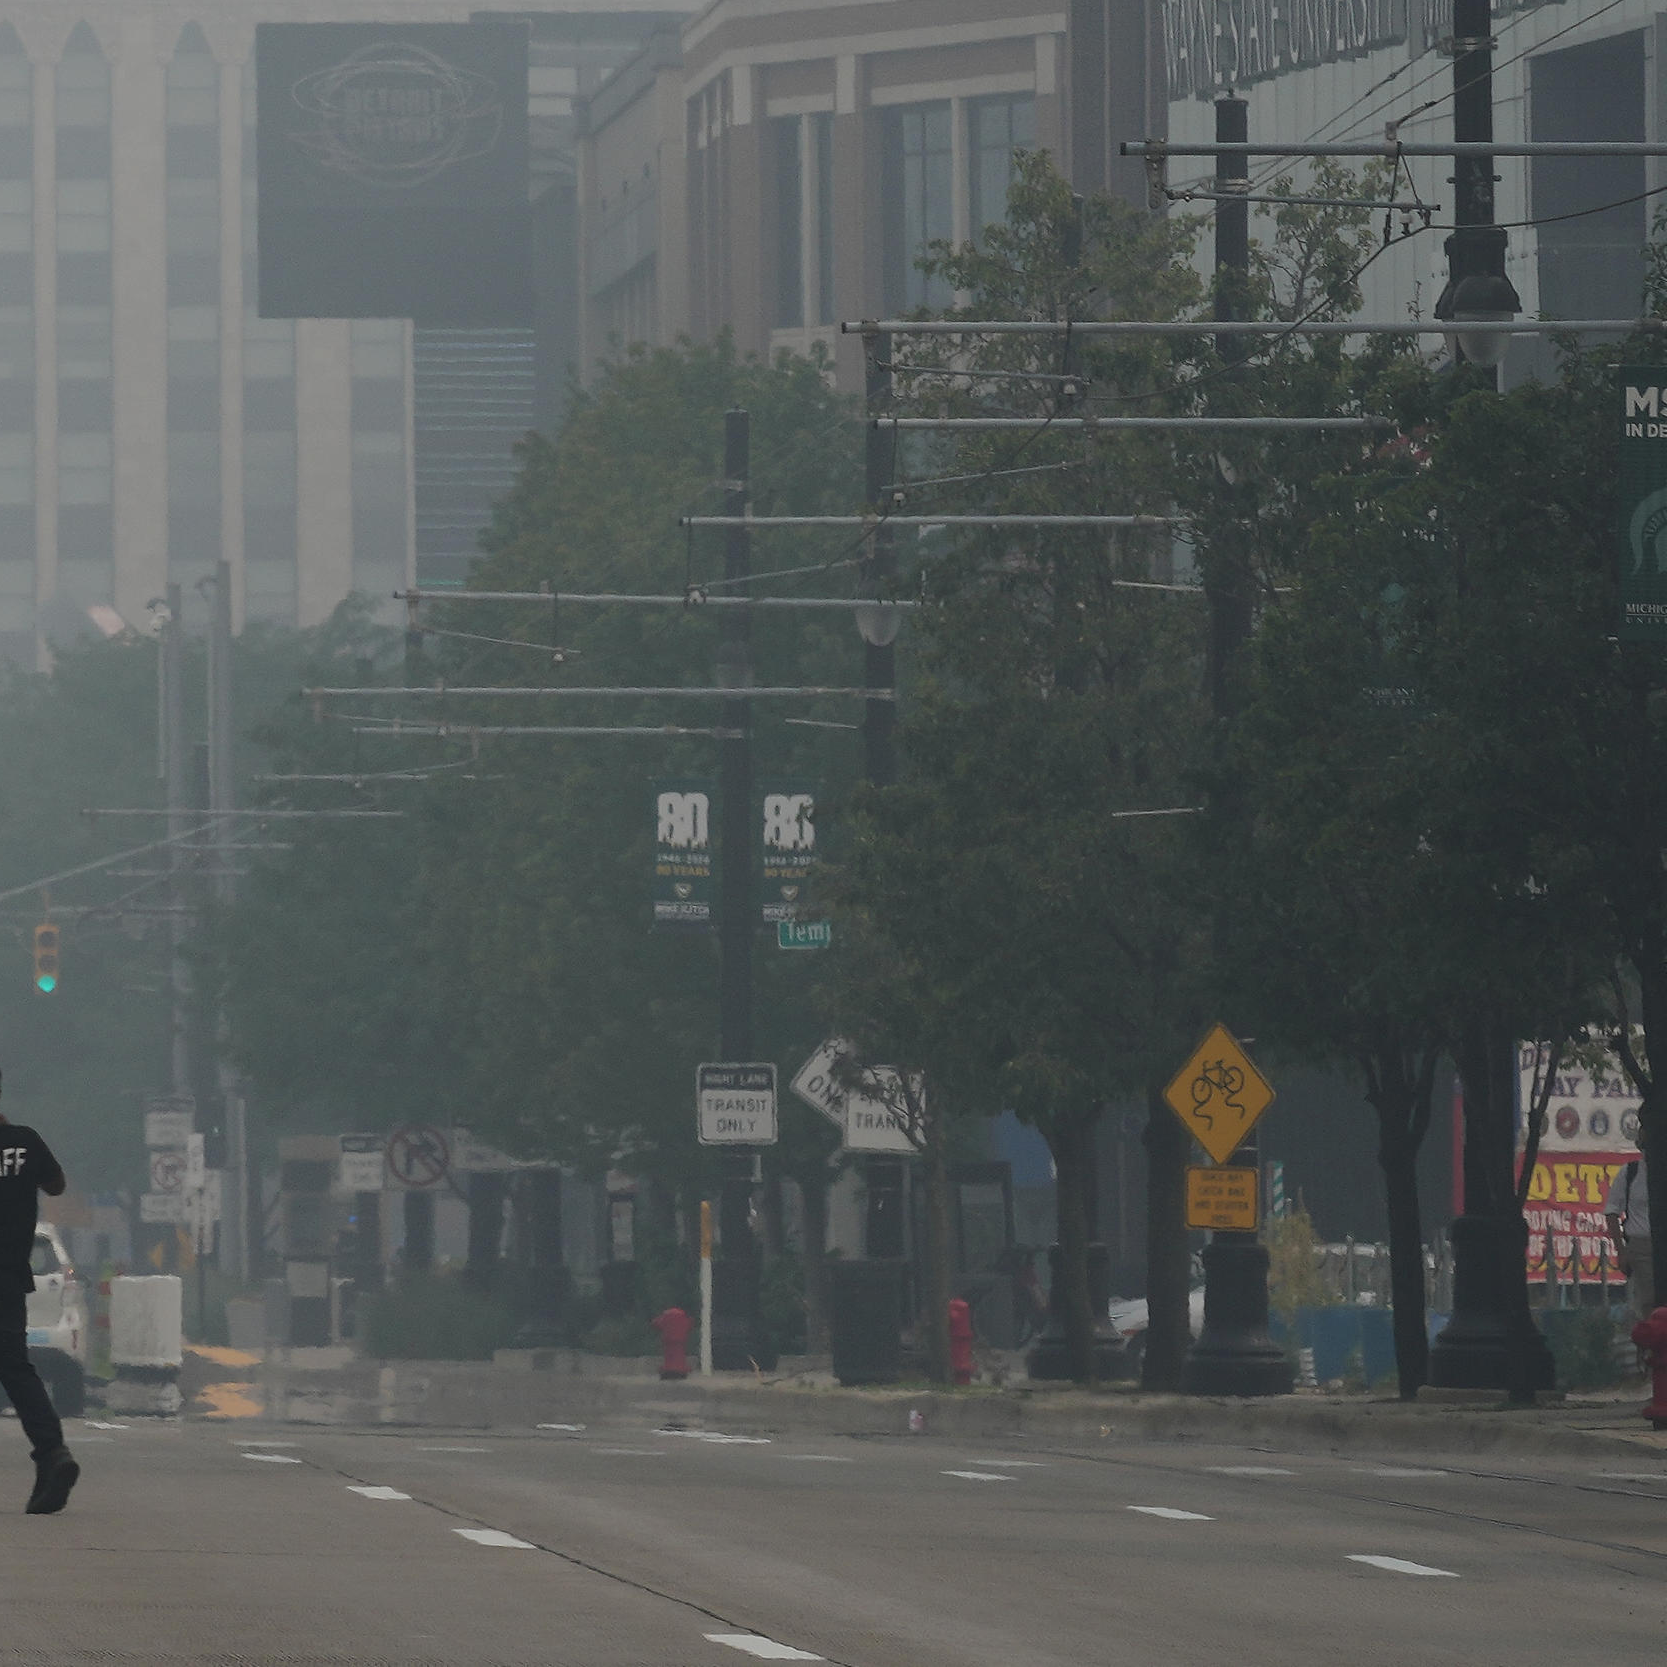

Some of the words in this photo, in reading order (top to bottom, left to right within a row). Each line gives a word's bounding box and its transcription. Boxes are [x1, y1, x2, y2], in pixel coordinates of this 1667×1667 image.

[1626, 423, 1643, 437] IN
[657, 792, 709, 848] 80
[786, 922, 831, 941] Tem
[707, 1097, 766, 1112] TRANSIT
[717, 1118, 756, 1133] ONLY
